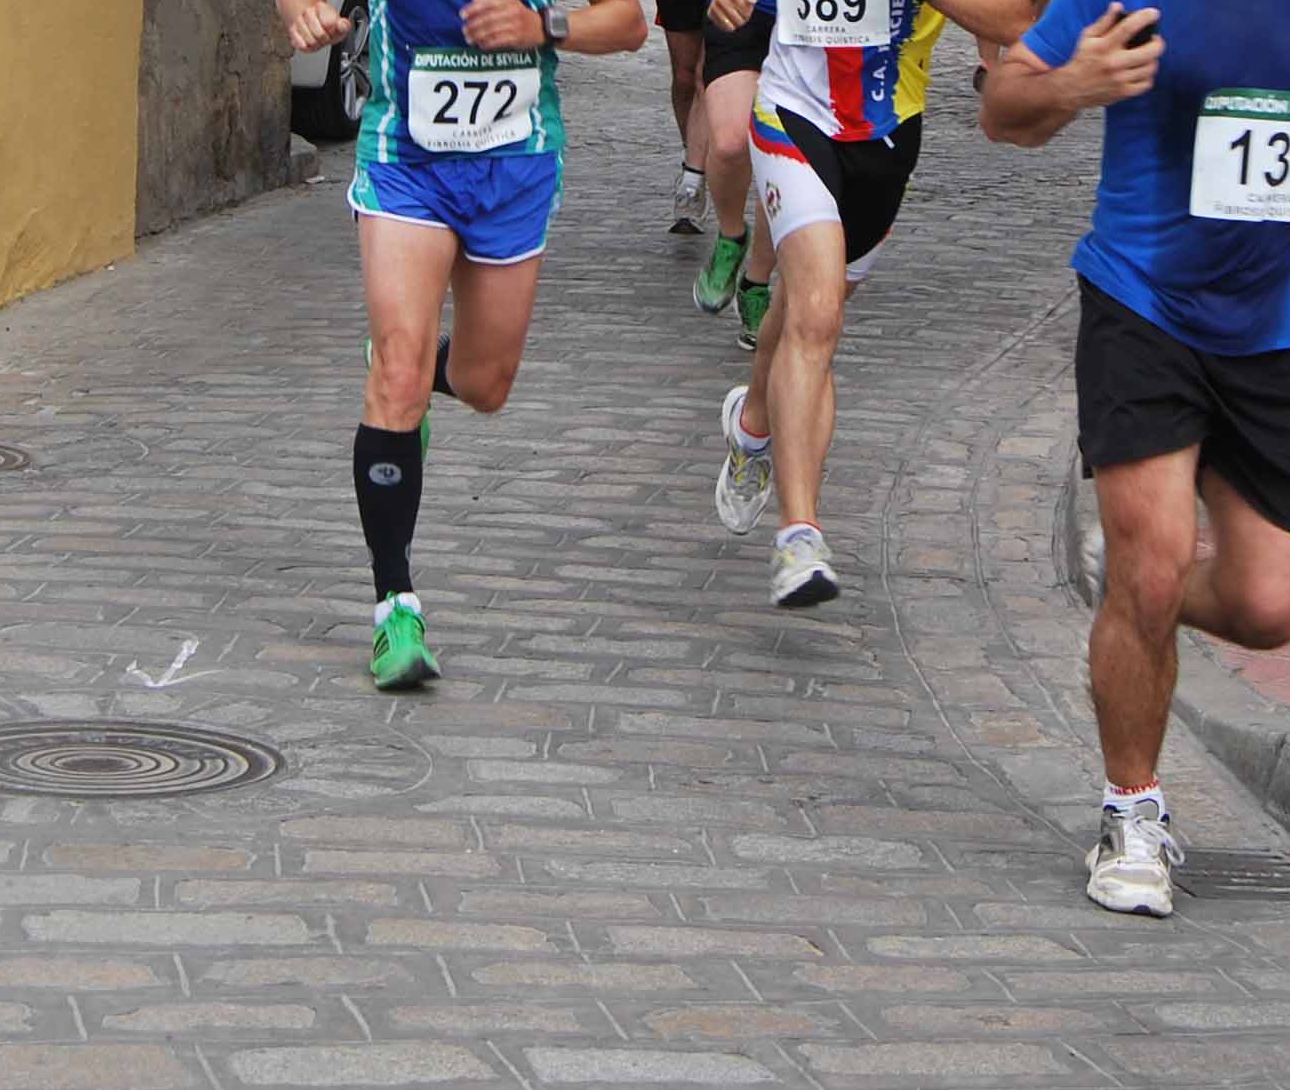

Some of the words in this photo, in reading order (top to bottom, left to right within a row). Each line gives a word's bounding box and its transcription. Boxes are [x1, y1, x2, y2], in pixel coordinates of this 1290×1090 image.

[415, 51, 479, 68] DIPUTACIÓN
[481, 54, 494, 67] DE
[496, 53, 532, 67] SEVILLA
[432, 79, 518, 125] 272
